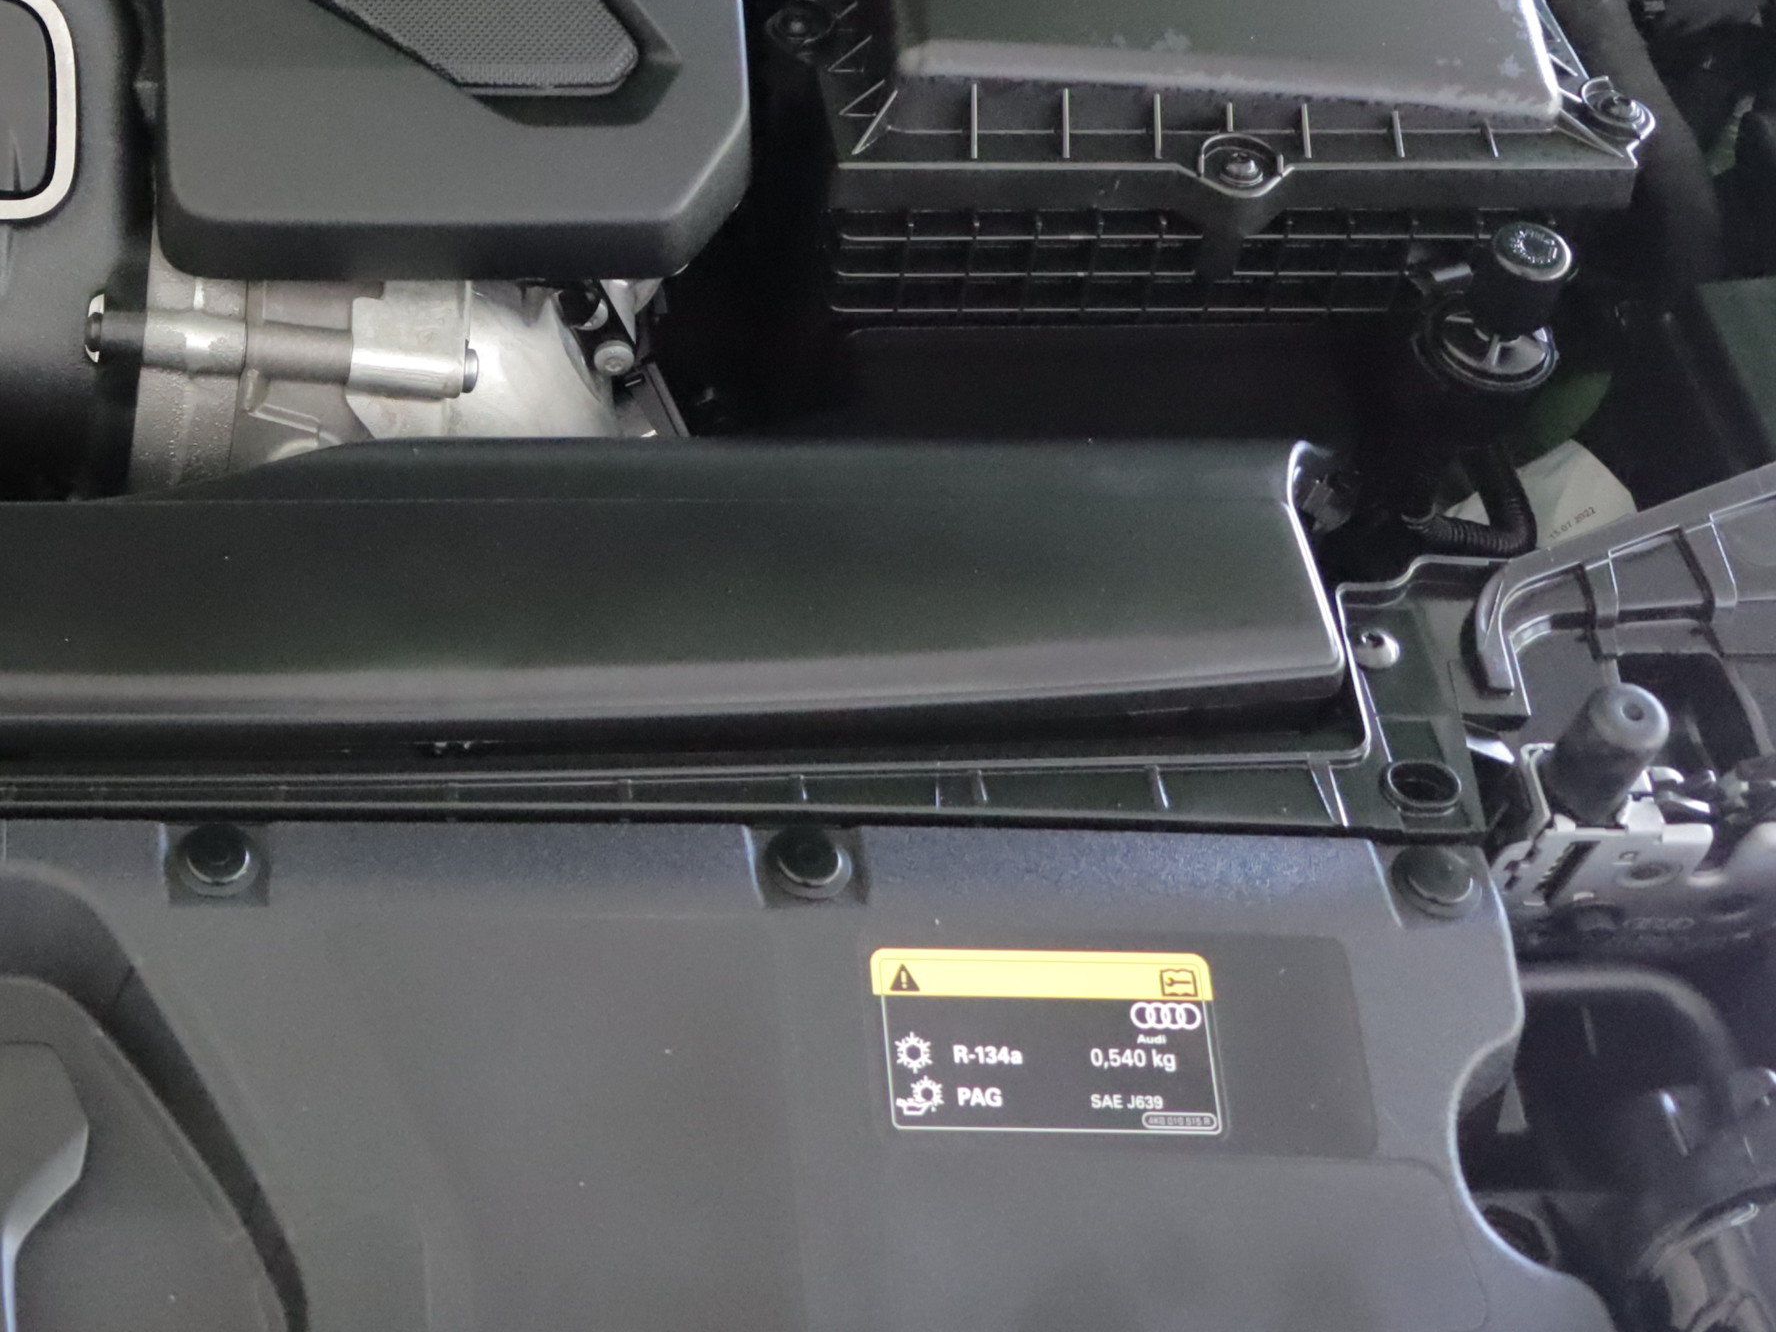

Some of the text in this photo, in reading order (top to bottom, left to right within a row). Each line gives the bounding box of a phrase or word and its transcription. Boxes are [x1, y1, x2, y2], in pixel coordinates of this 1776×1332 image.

[1136, 1033, 1167, 1045] Audi
[952, 1044, 1023, 1065] R-134a
[1090, 1048, 1177, 1072] 0,540 kg
[957, 1086, 1003, 1107] PAG
[1090, 1094, 1163, 1109] SAE J639
